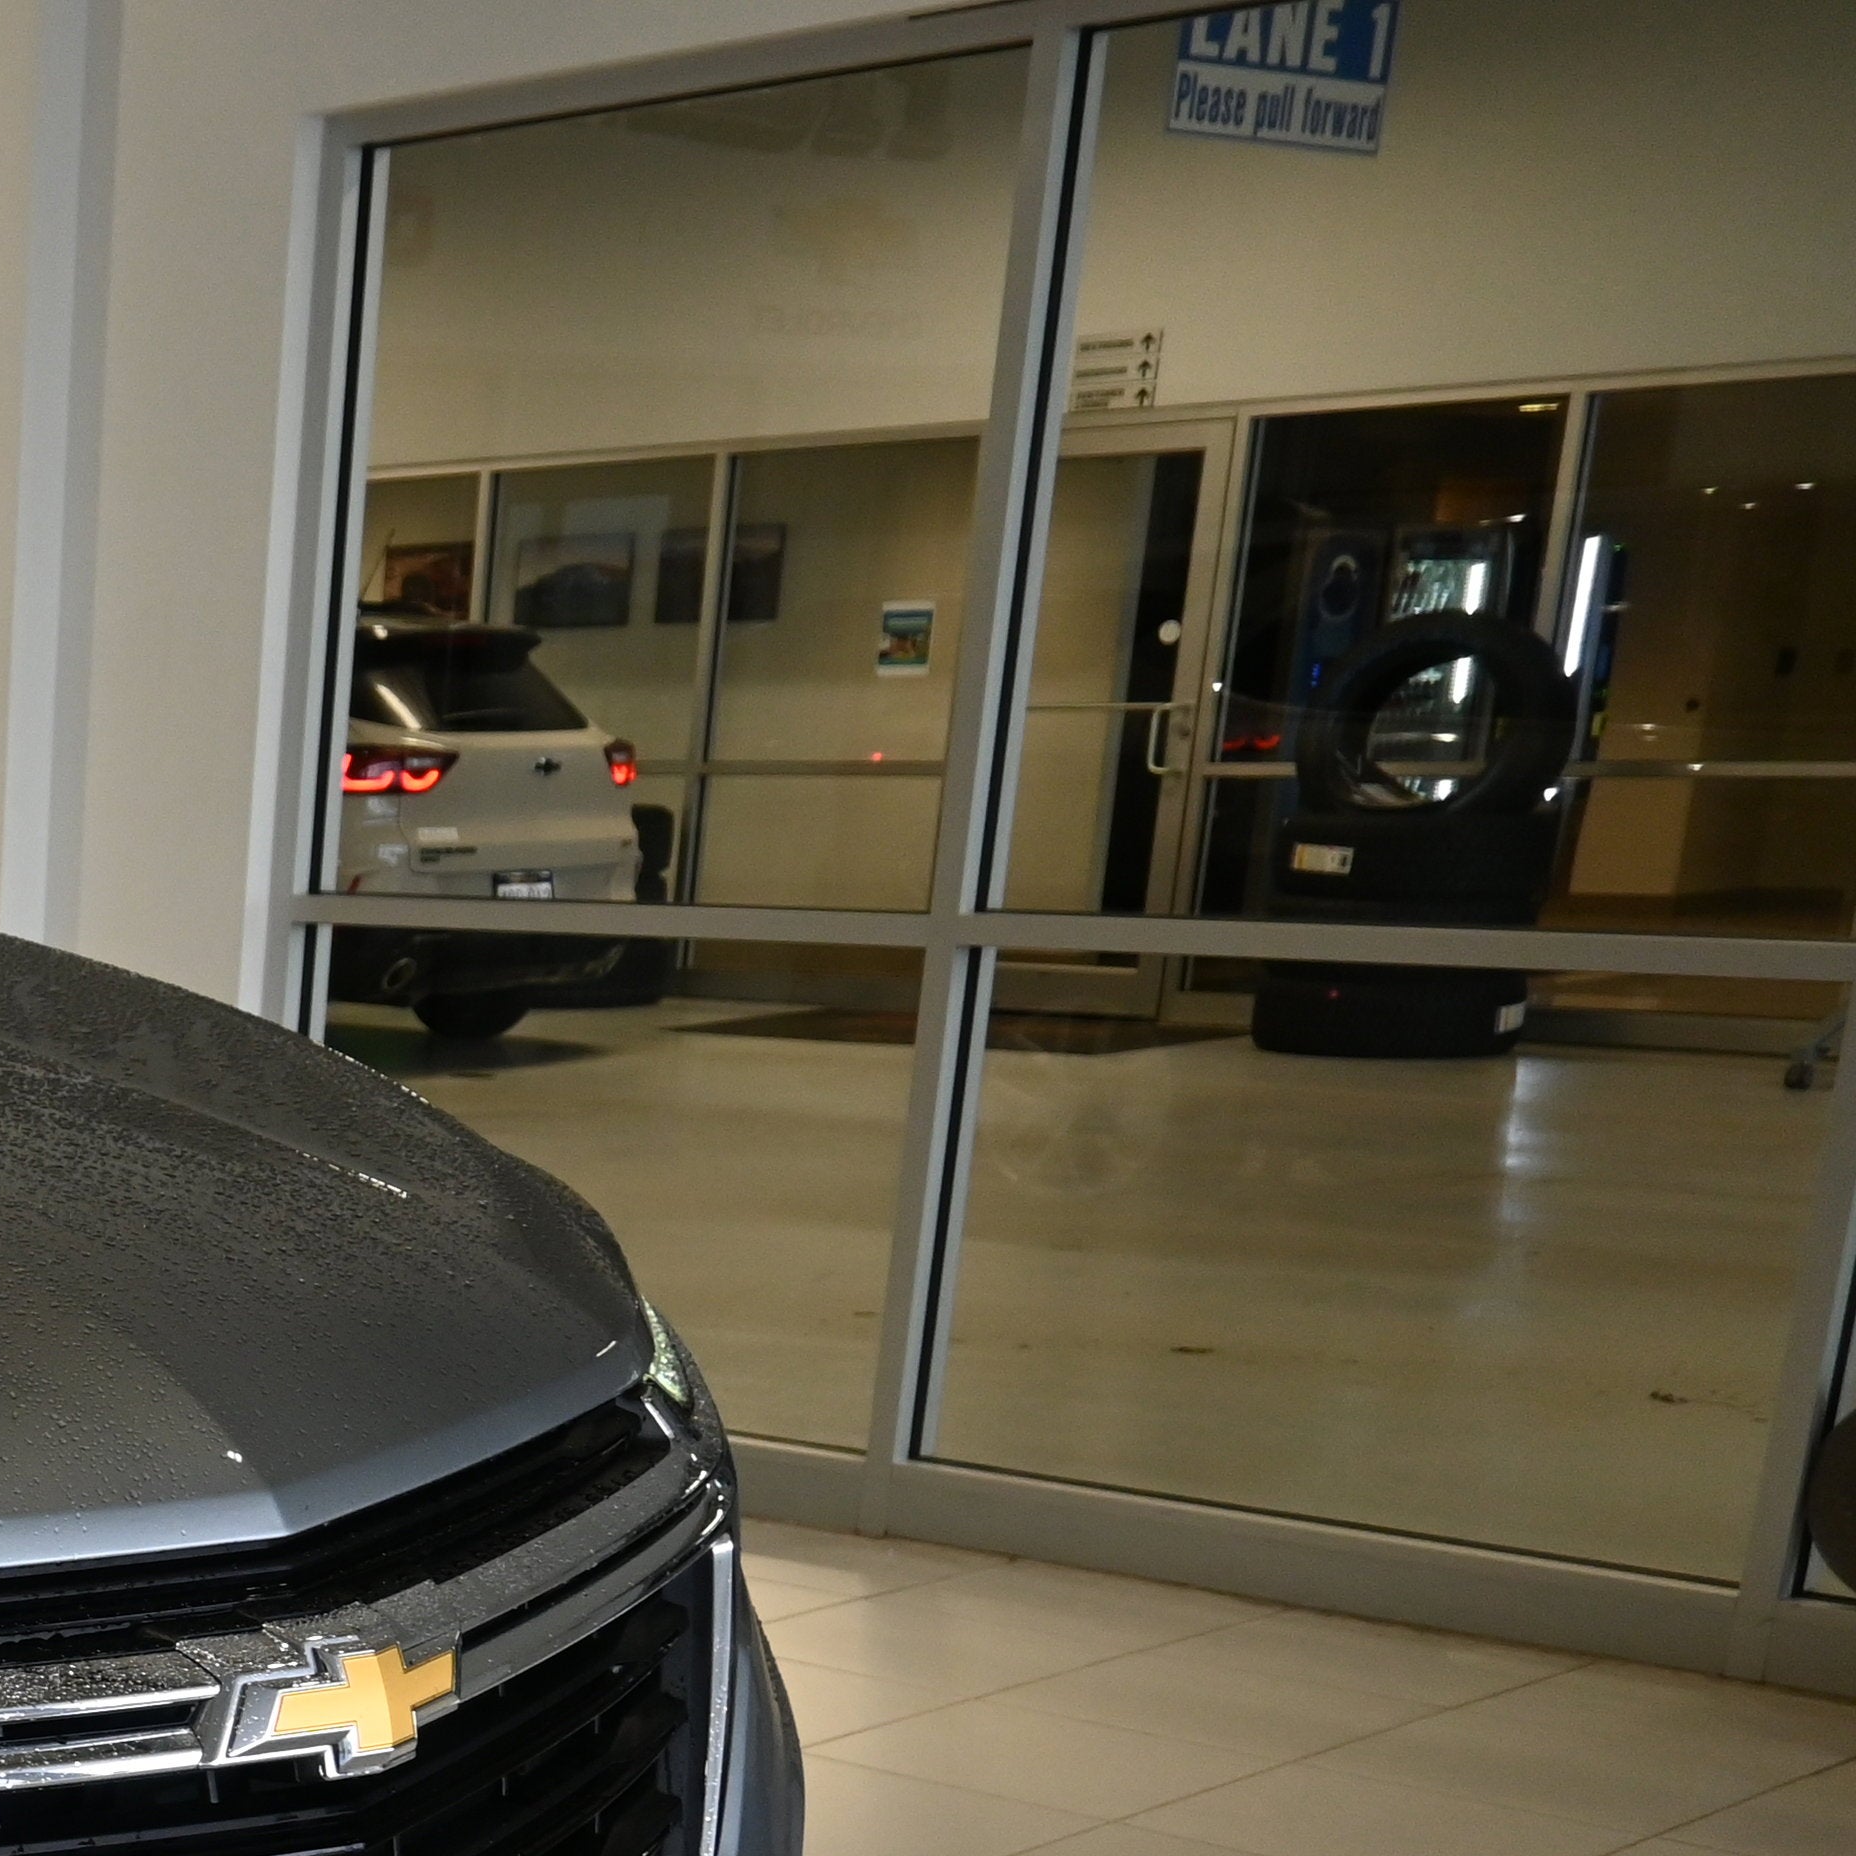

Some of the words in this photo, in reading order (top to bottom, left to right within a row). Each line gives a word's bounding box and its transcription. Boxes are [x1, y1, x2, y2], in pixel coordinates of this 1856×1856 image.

[1189, 0, 1343, 73] LANE
[1367, 2, 1391, 79] 1
[1174, 71, 1248, 127] Please
[1253, 83, 1296, 136] pull
[1301, 87, 1381, 145] forward
